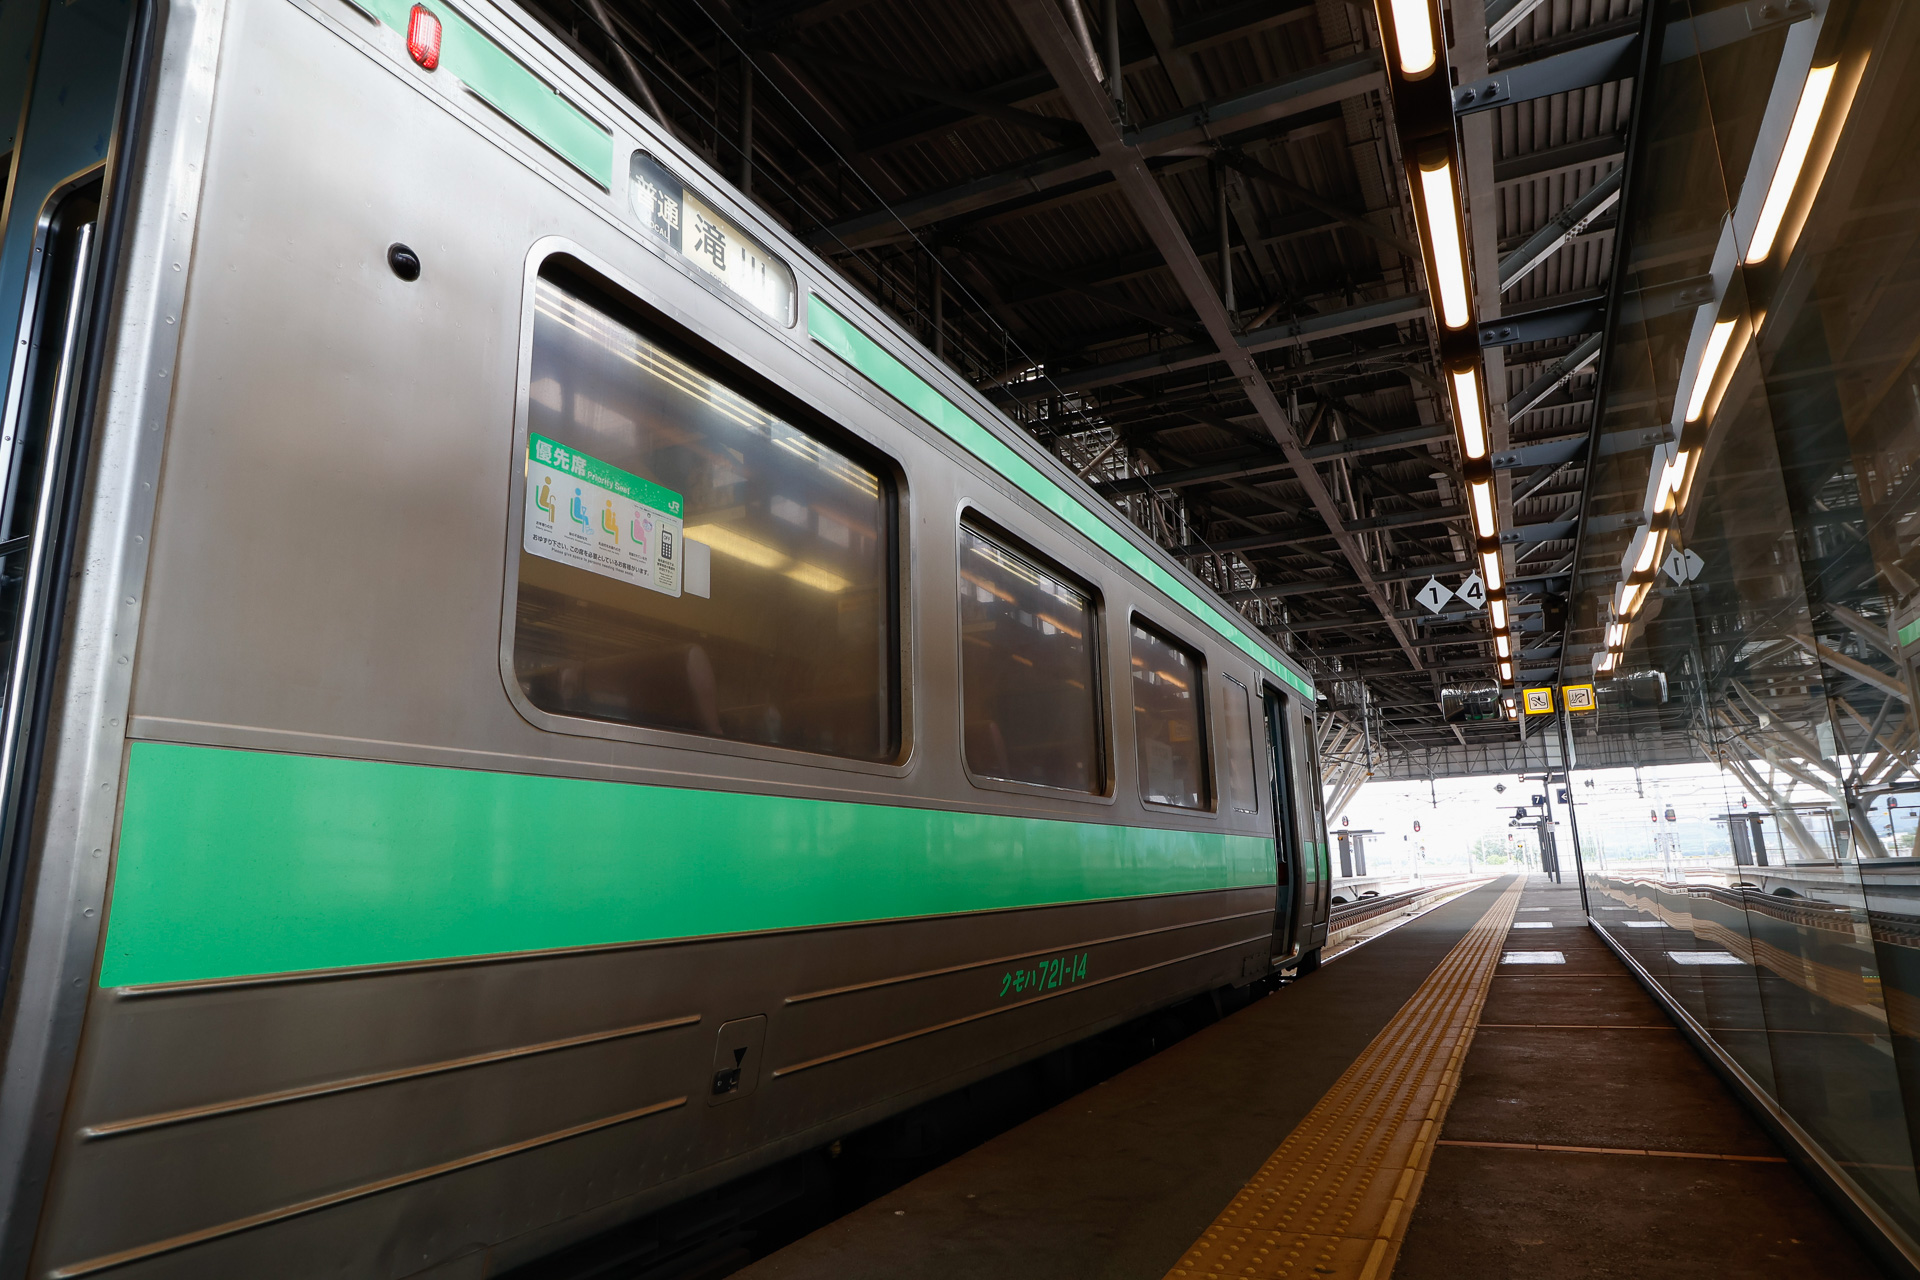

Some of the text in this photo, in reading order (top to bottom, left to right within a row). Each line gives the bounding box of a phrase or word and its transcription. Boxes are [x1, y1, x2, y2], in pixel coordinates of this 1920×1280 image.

[535, 439, 587, 477] 優先席
[587, 470, 631, 495] Priority Seat
[668, 500, 680, 512] JR
[1428, 586, 1439, 605] 1
[1466, 582, 1483, 600] 4
[1496, 784, 1504, 792] 5
[1534, 796, 1541, 804] 7
